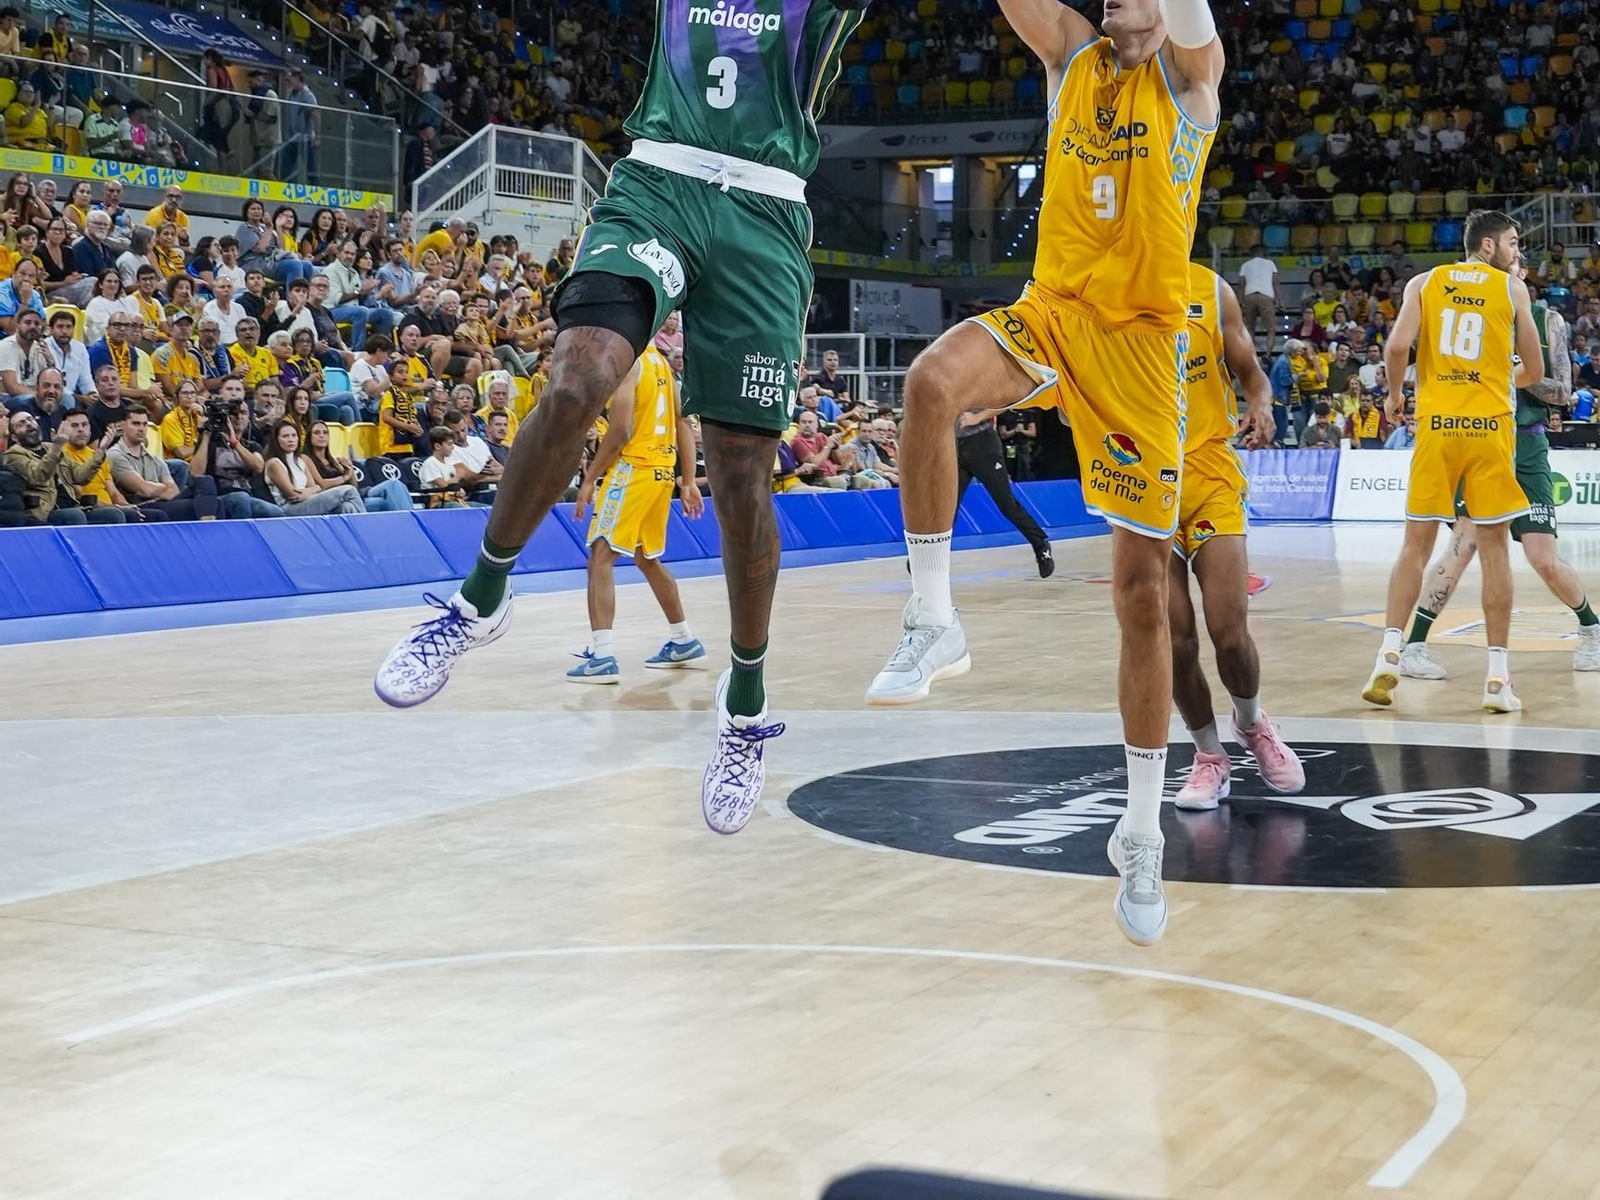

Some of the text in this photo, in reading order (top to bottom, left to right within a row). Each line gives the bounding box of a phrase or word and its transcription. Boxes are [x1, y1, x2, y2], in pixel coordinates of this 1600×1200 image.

[705, 56, 739, 110] 3
[1092, 175, 1117, 220] 9
[1439, 308, 1484, 361] 18
[744, 351, 777, 366] sabor
[742, 362, 786, 386] a má
[740, 376, 784, 408] laga
[1431, 414, 1499, 431] Barceló
[1090, 459, 1148, 491] Poema
[1350, 477, 1407, 491] ENGEL
[1090, 477, 1145, 504] del Mar
